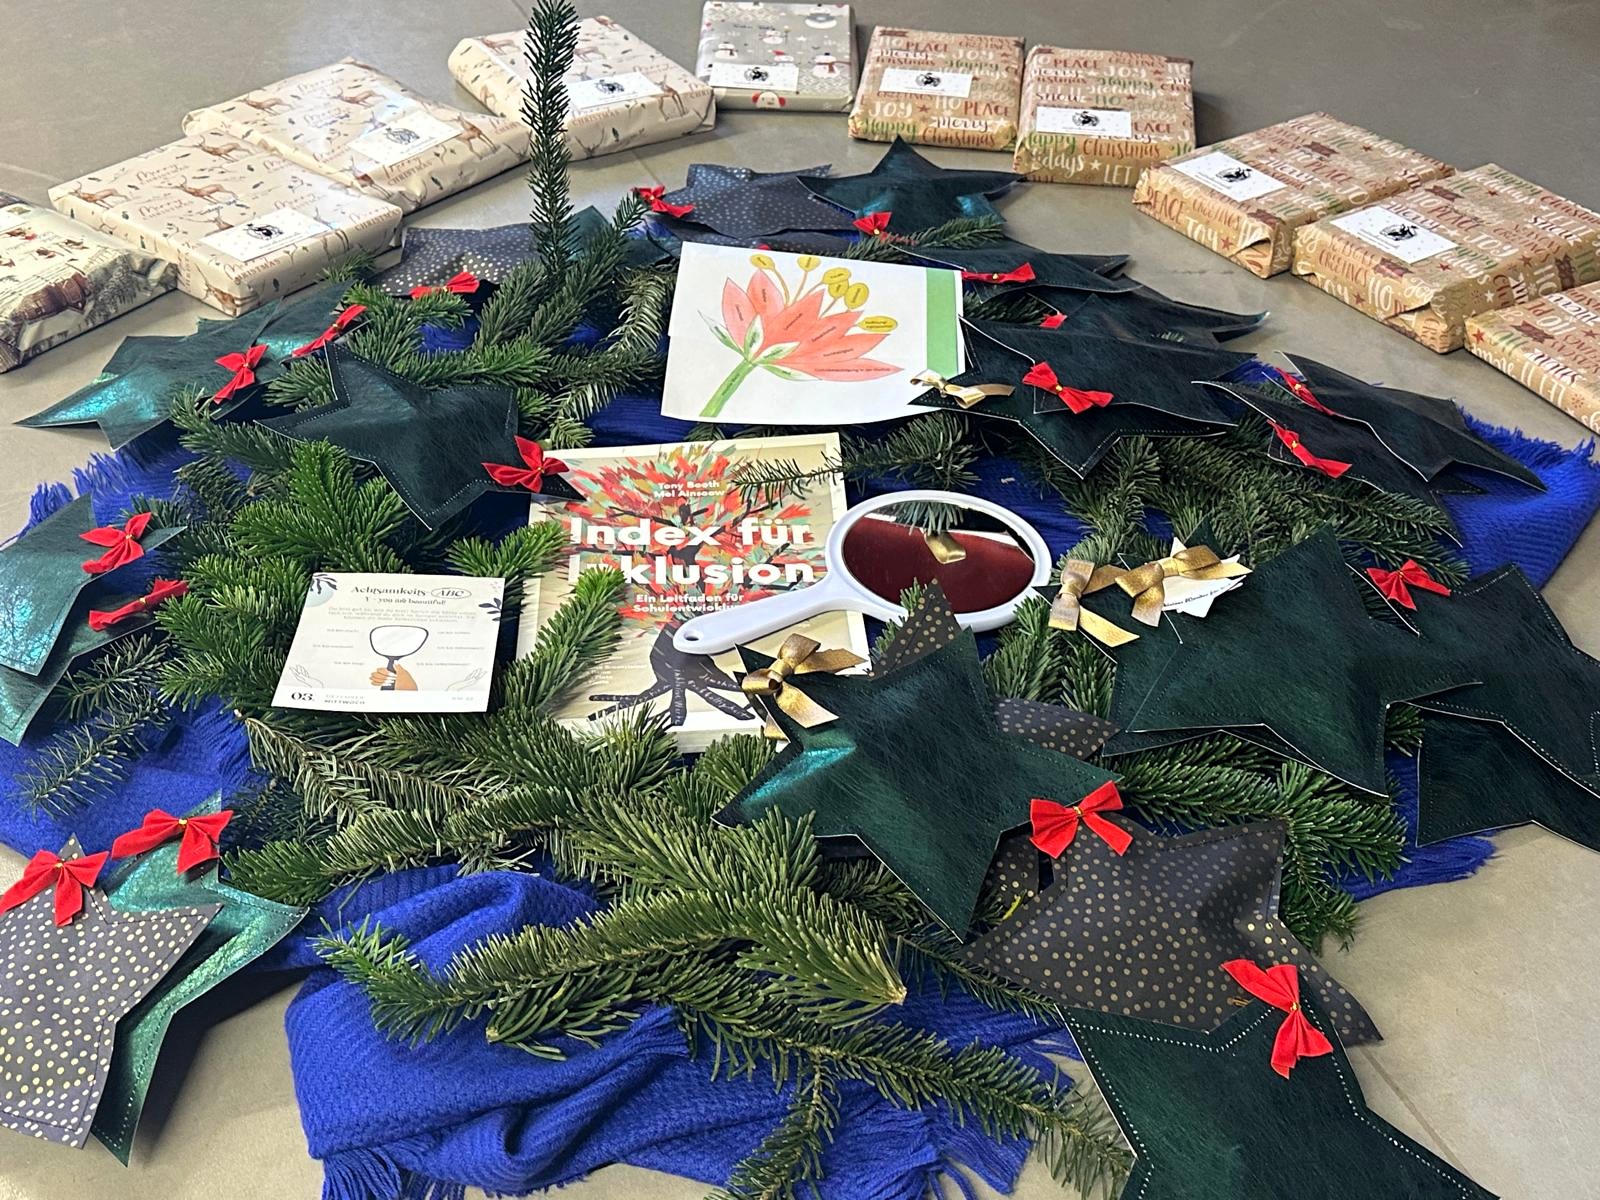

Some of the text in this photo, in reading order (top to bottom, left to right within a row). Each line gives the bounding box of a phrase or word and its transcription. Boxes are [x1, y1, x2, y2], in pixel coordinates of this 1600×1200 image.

[869, 101, 1009, 118] JOY PEACE
[1134, 122, 1173, 135] EACE
[658, 480, 720, 491] Tony Booth
[654, 490, 676, 498] Mel
[569, 515, 815, 546] Index für
[568, 554, 815, 585] Iklusion
[636, 592, 745, 603] Ein Leitfaden für
